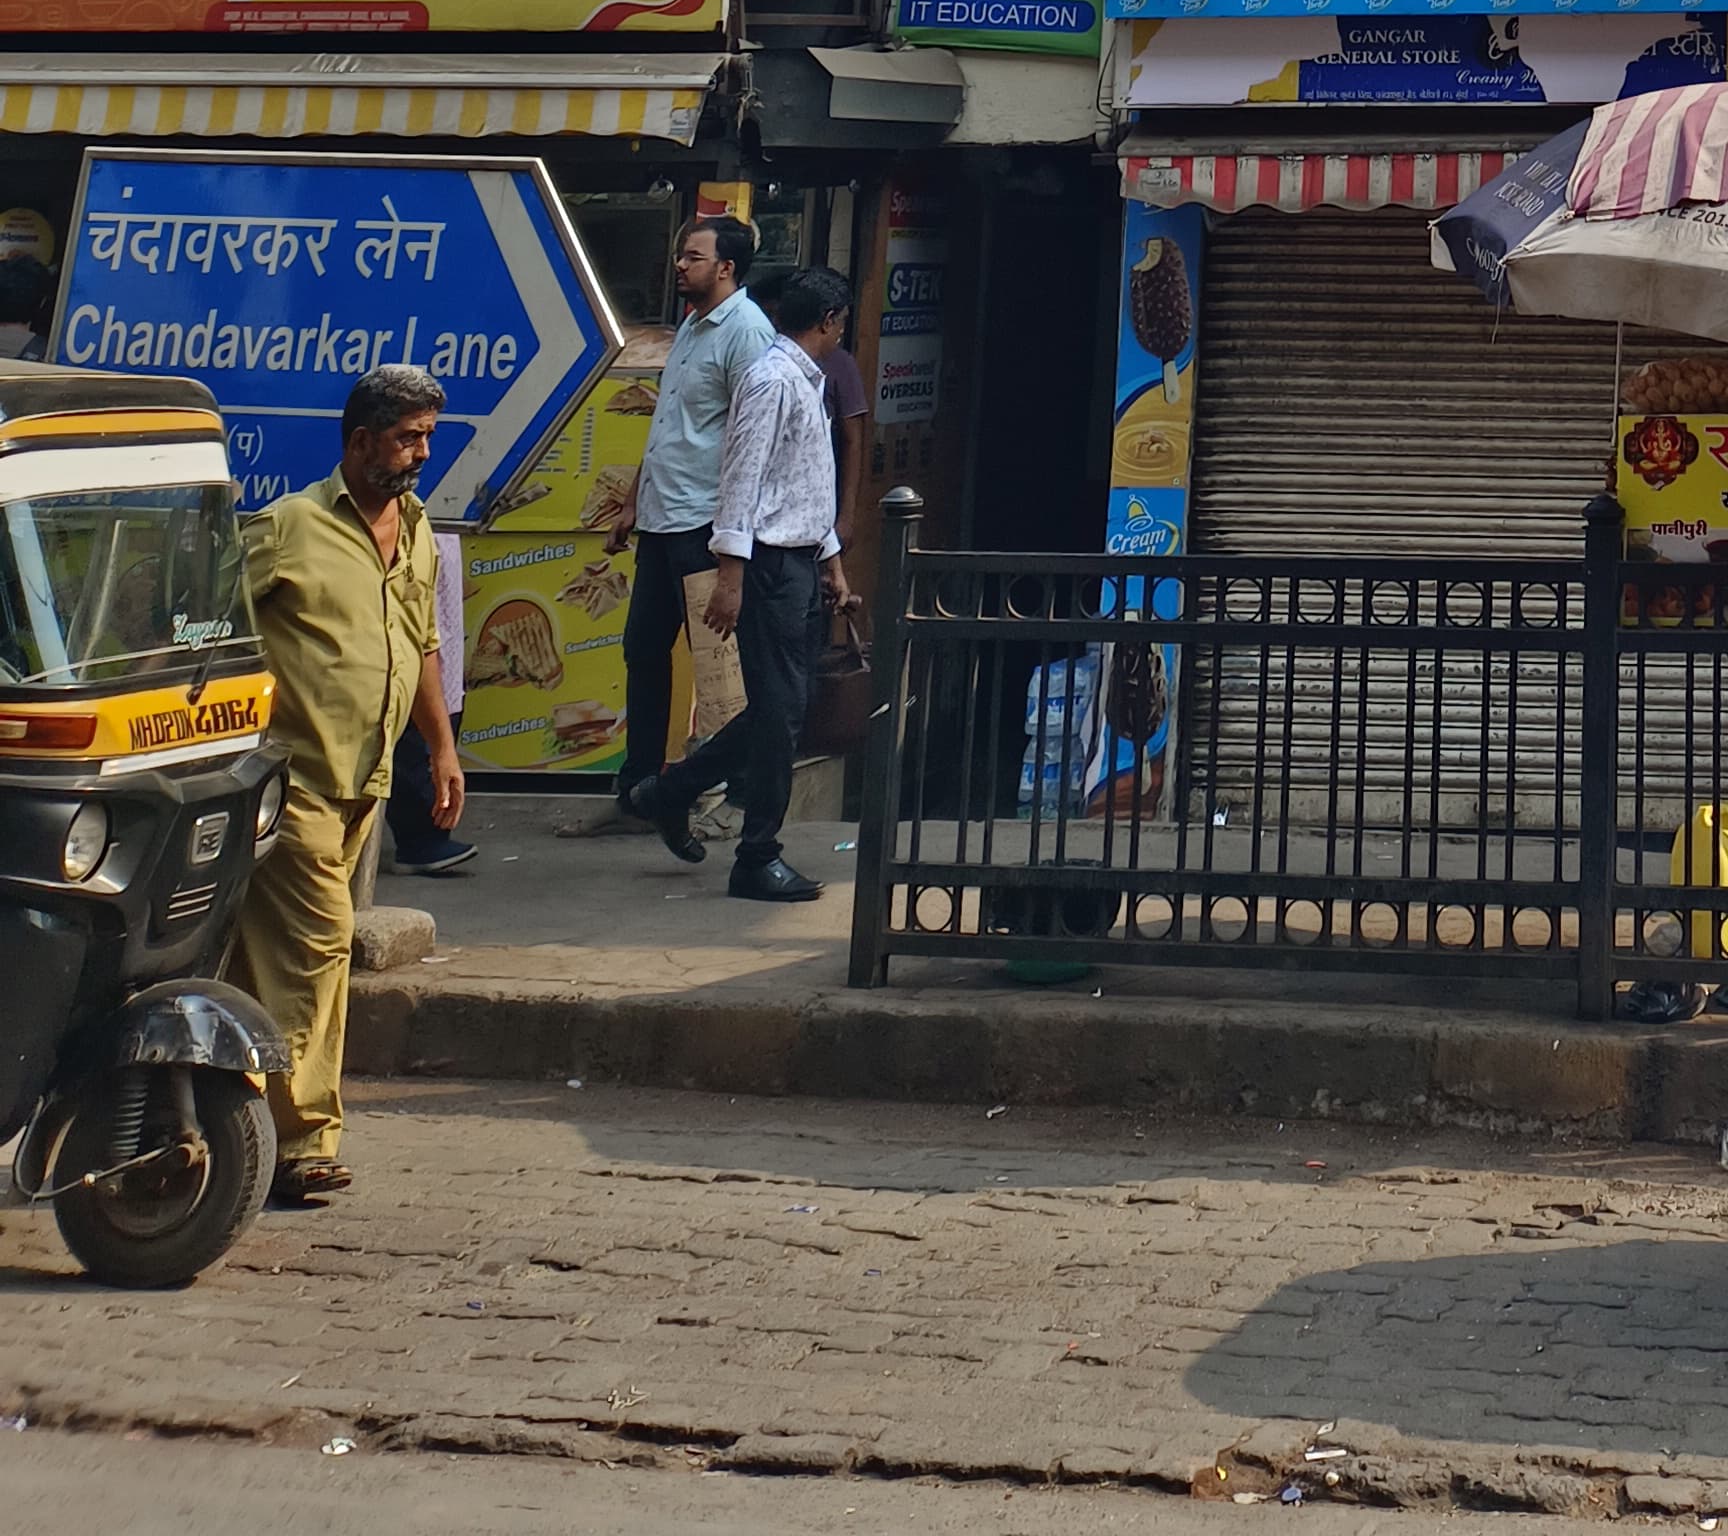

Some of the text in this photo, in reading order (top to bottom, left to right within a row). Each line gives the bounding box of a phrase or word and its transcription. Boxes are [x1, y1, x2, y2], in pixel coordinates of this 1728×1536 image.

[910, 0, 1077, 27] IT EDUCATION
[1349, 29, 1427, 46] GANGAR
[1312, 49, 1461, 65] GENERAL STORE
[87, 186, 446, 281] चंदावरकर लेन
[65, 303, 517, 380] Chandavarkar Lane
[881, 381, 934, 400] OVERSEAS
[1108, 527, 1167, 555] Cream
[1651, 519, 1708, 542] पानीपुरी
[470, 543, 576, 577] Sandwiches
[461, 716, 547, 745] Sandwiches
